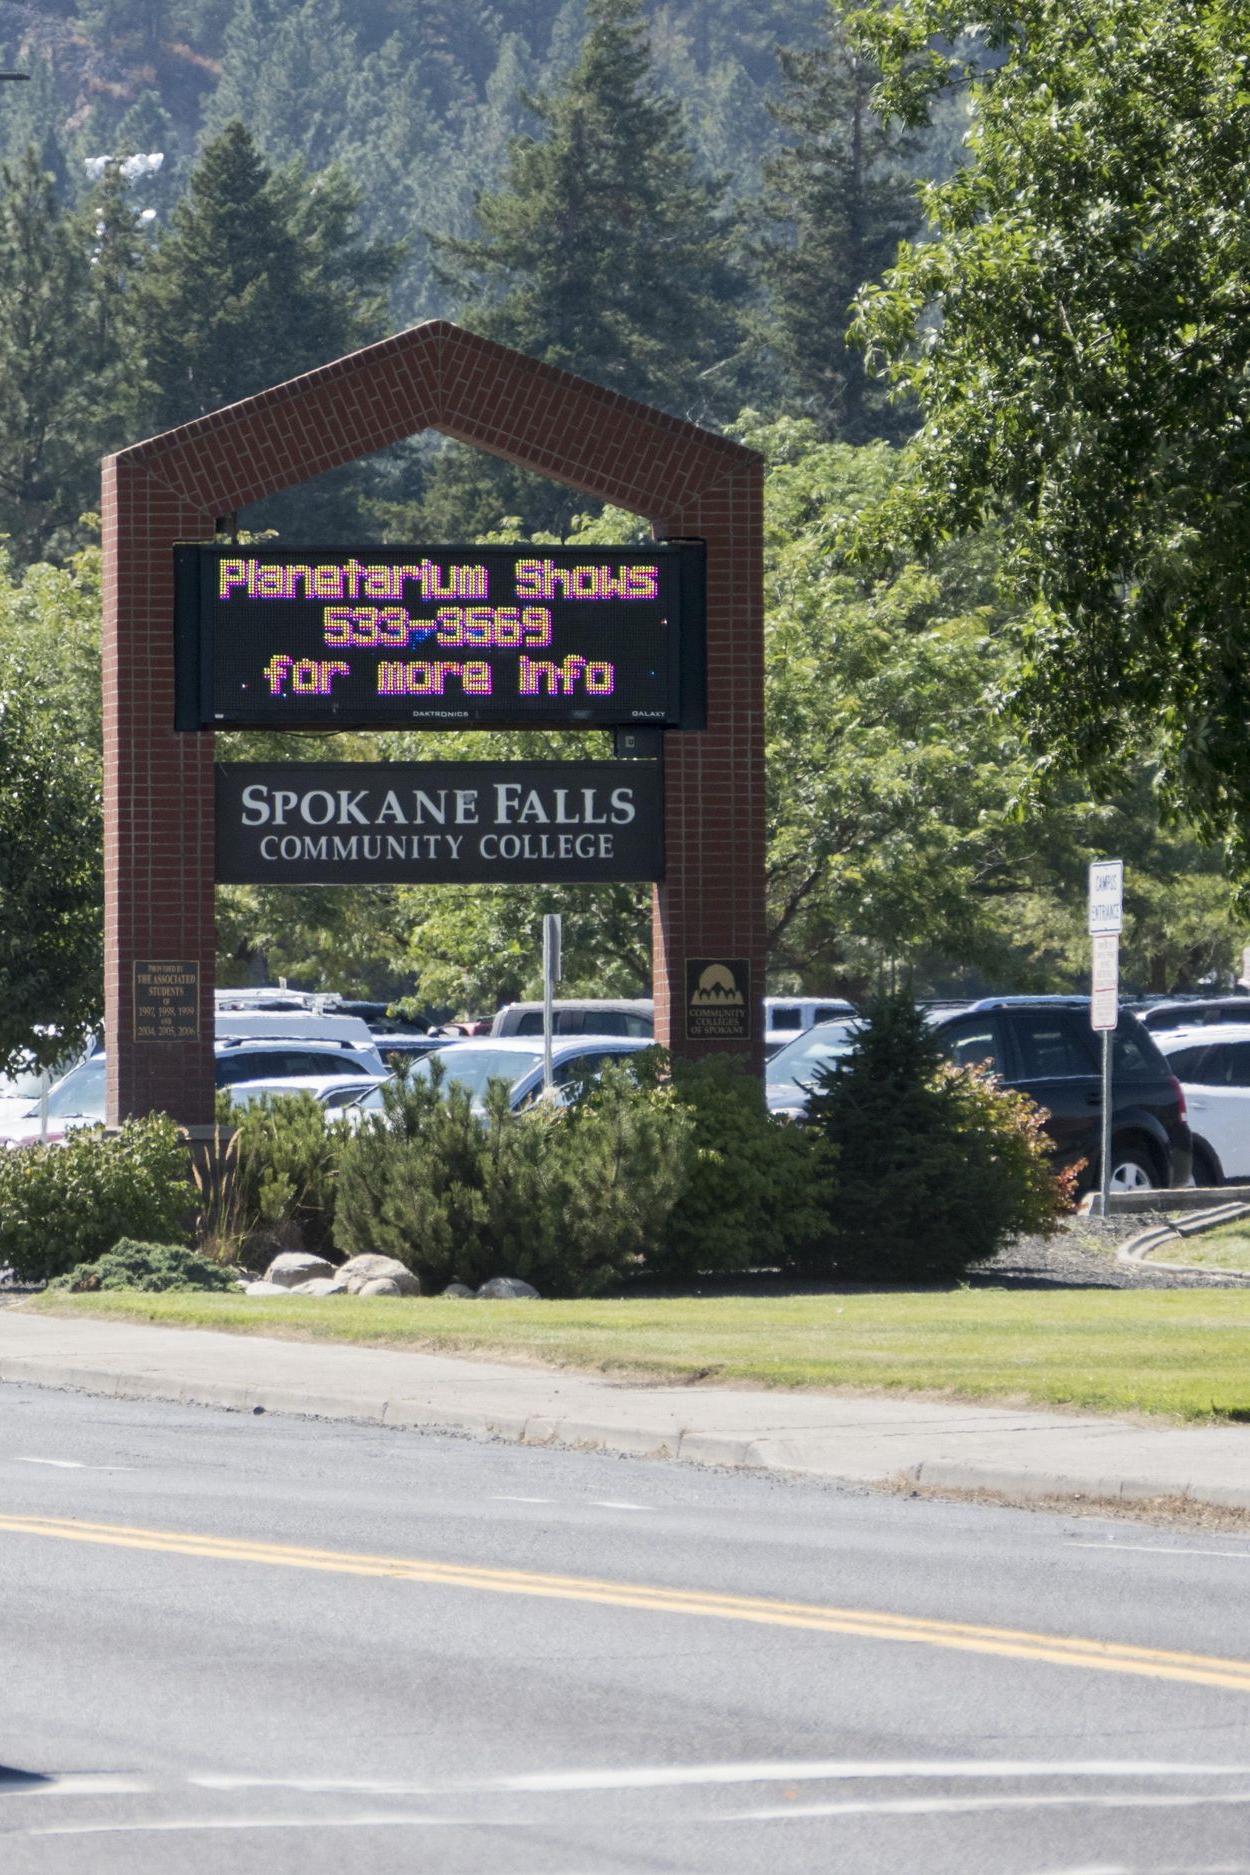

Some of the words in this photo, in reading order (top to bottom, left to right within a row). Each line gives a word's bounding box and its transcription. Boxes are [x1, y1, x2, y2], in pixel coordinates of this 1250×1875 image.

[219, 558, 488, 599] Planetarium
[515, 559, 658, 599] Shows
[323, 606, 553, 648] 533-3569
[263, 655, 350, 695] for
[377, 659, 493, 695] more
[518, 655, 615, 695] info
[412, 710, 469, 718] DAKTRONICS
[631, 710, 665, 718] GALAXY
[241, 783, 478, 825] SPOKANE
[493, 783, 636, 825] FALLS
[260, 834, 462, 860] COMMUNITY
[479, 833, 614, 860] COLLEGE
[149, 986, 184, 996] STUDENTS
[689, 1008, 745, 1017] COMMUNITY
[695, 1017, 740, 1026] COLLEGES
[704, 1026, 744, 1035] SPOKANE
